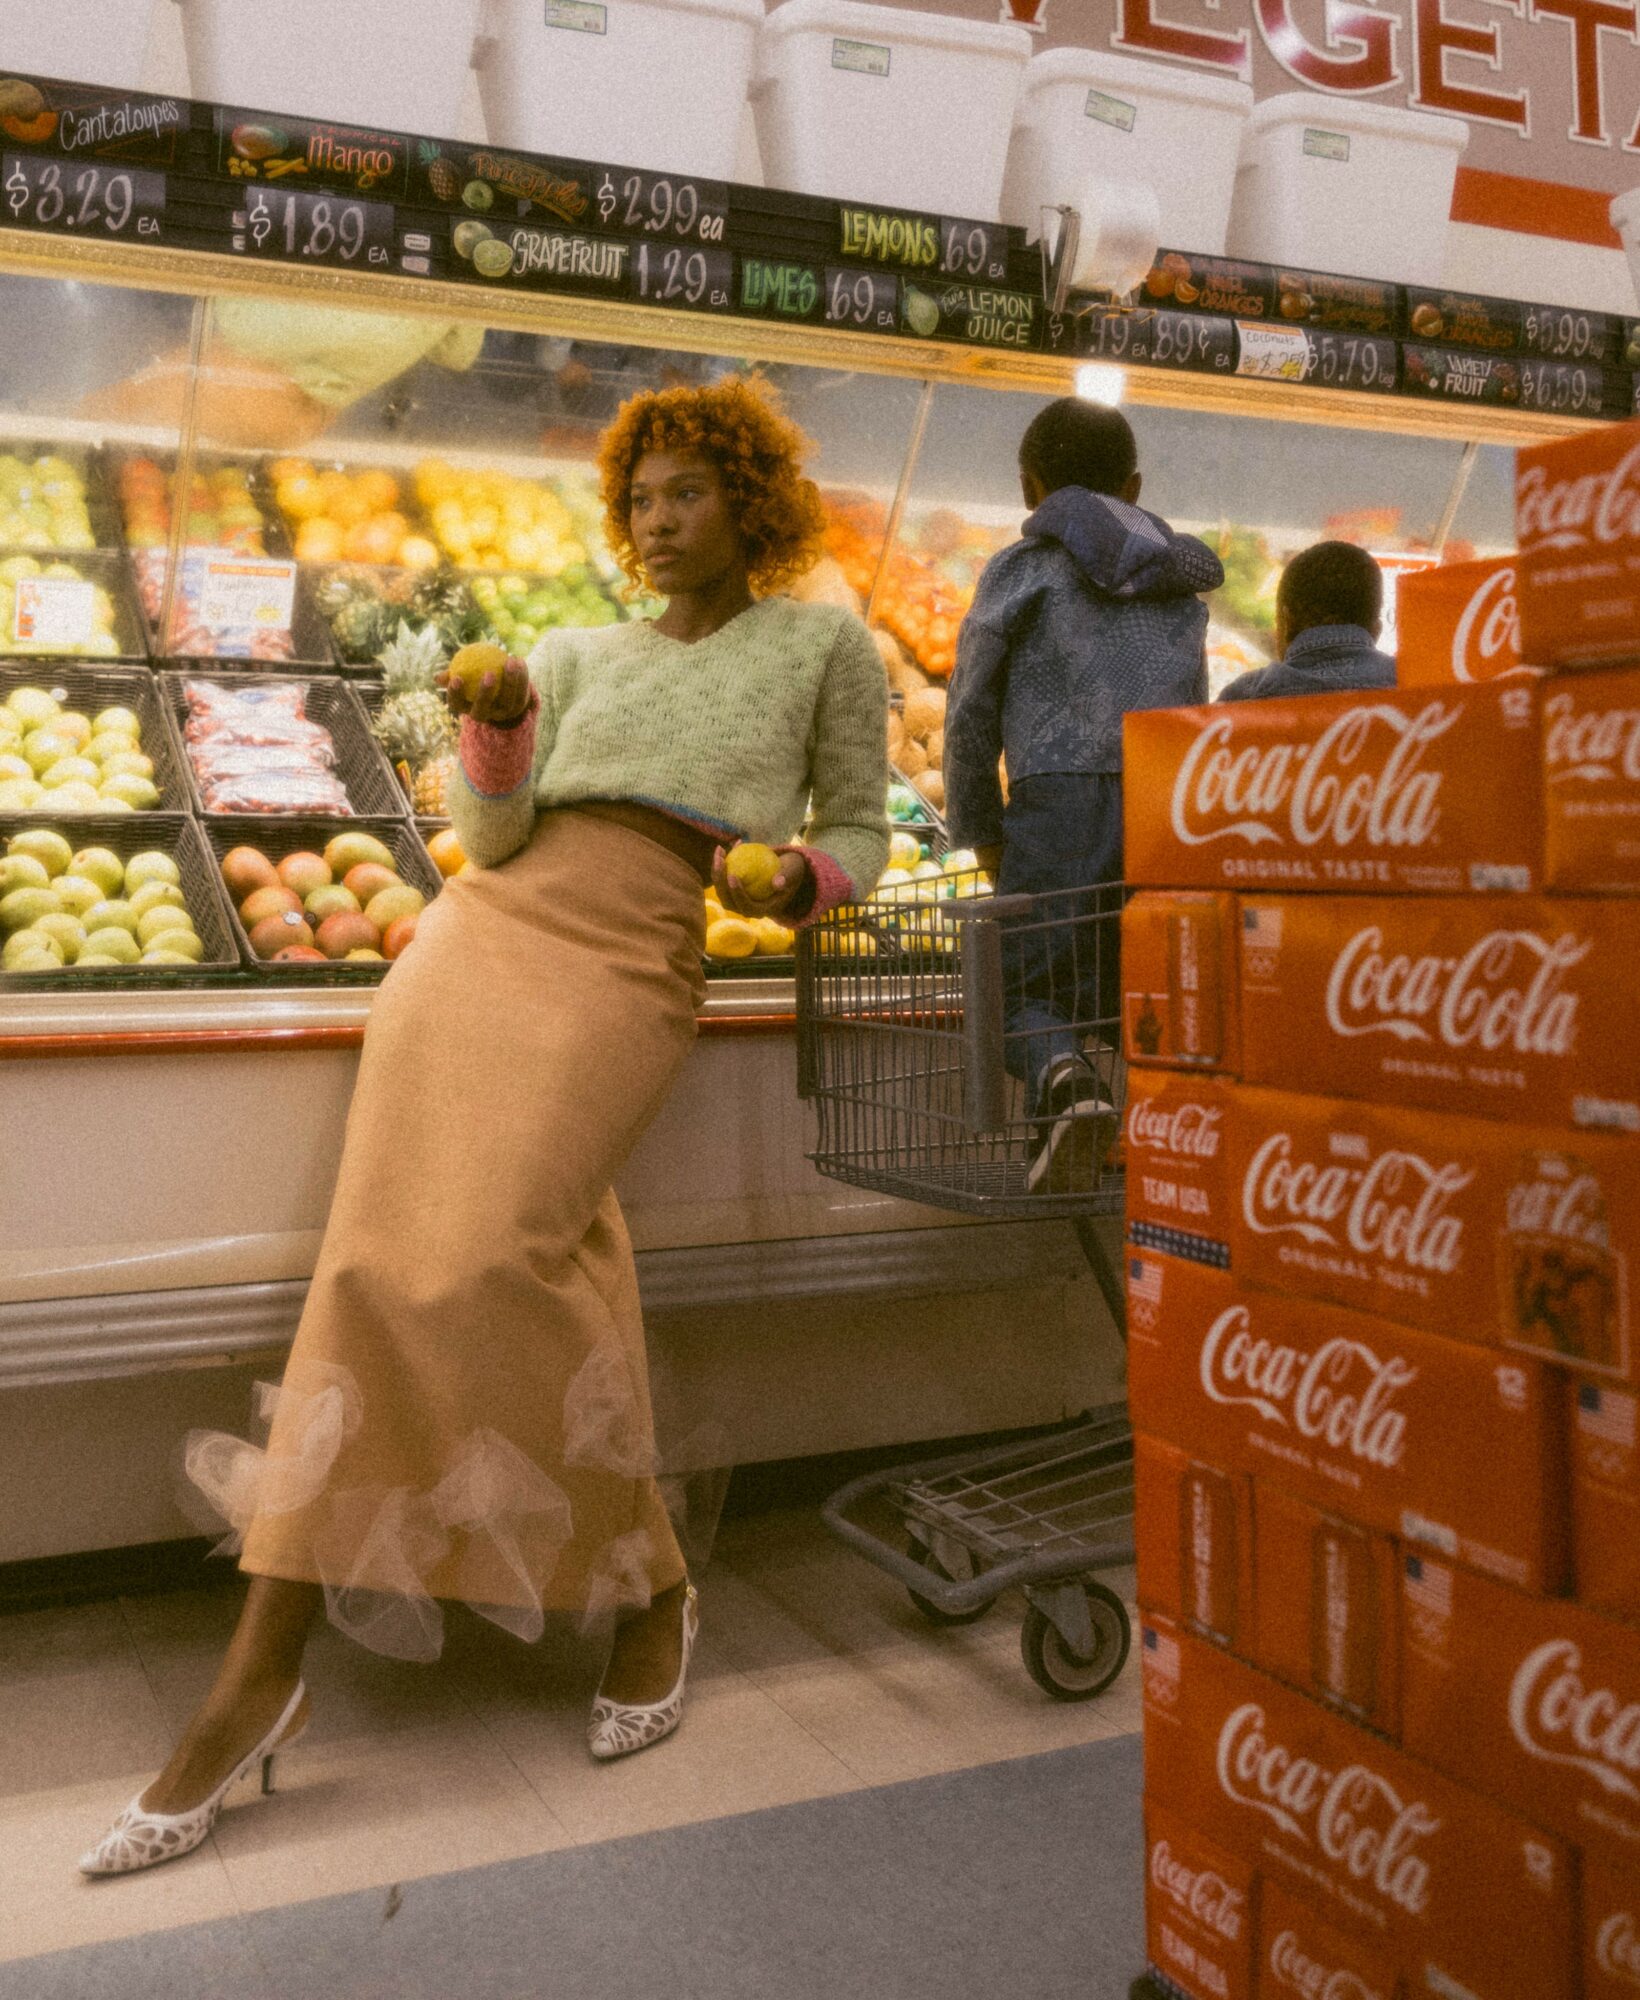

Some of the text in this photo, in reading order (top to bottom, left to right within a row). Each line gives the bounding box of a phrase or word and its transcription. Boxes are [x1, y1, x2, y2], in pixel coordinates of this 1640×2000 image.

[1000, 0, 1640, 153] EGET
[60, 99, 179, 152] Cantaloupes
[308, 134, 393, 188] Mango
[137, 216, 160, 235] EA
[699, 214, 725, 241] ea
[841, 209, 939, 266] LEMONS
[940, 224, 1005, 279] .69 EA
[368, 246, 389, 264] EA
[512, 230, 629, 281] GRAPEFRUIT
[637, 245, 729, 306] 1.29 EA
[826, 272, 894, 326] .69 EA
[968, 288, 1032, 320] LEMON
[967, 315, 1030, 344] JUICE
[1132, 343, 1147, 358] EA
[1215, 353, 1231, 368] EA
[1444, 372, 1488, 397] FRUIT
[1446, 354, 1493, 377] VARIETY
[1170, 700, 1465, 847] Coca-Cola
[1222, 858, 1318, 881] ORIGINAL
[1323, 859, 1391, 882] TASTE
[1325, 924, 1594, 1057] Coca-Cola
[1128, 1098, 1224, 1159] Coca-Cola
[1243, 1133, 1475, 1273] Coca-Cola
[1200, 1304, 1420, 1467] Coca-Cola
[1216, 1702, 1440, 1915] Coca-Cola
[1151, 1839, 1244, 1940] Coca-Cola
